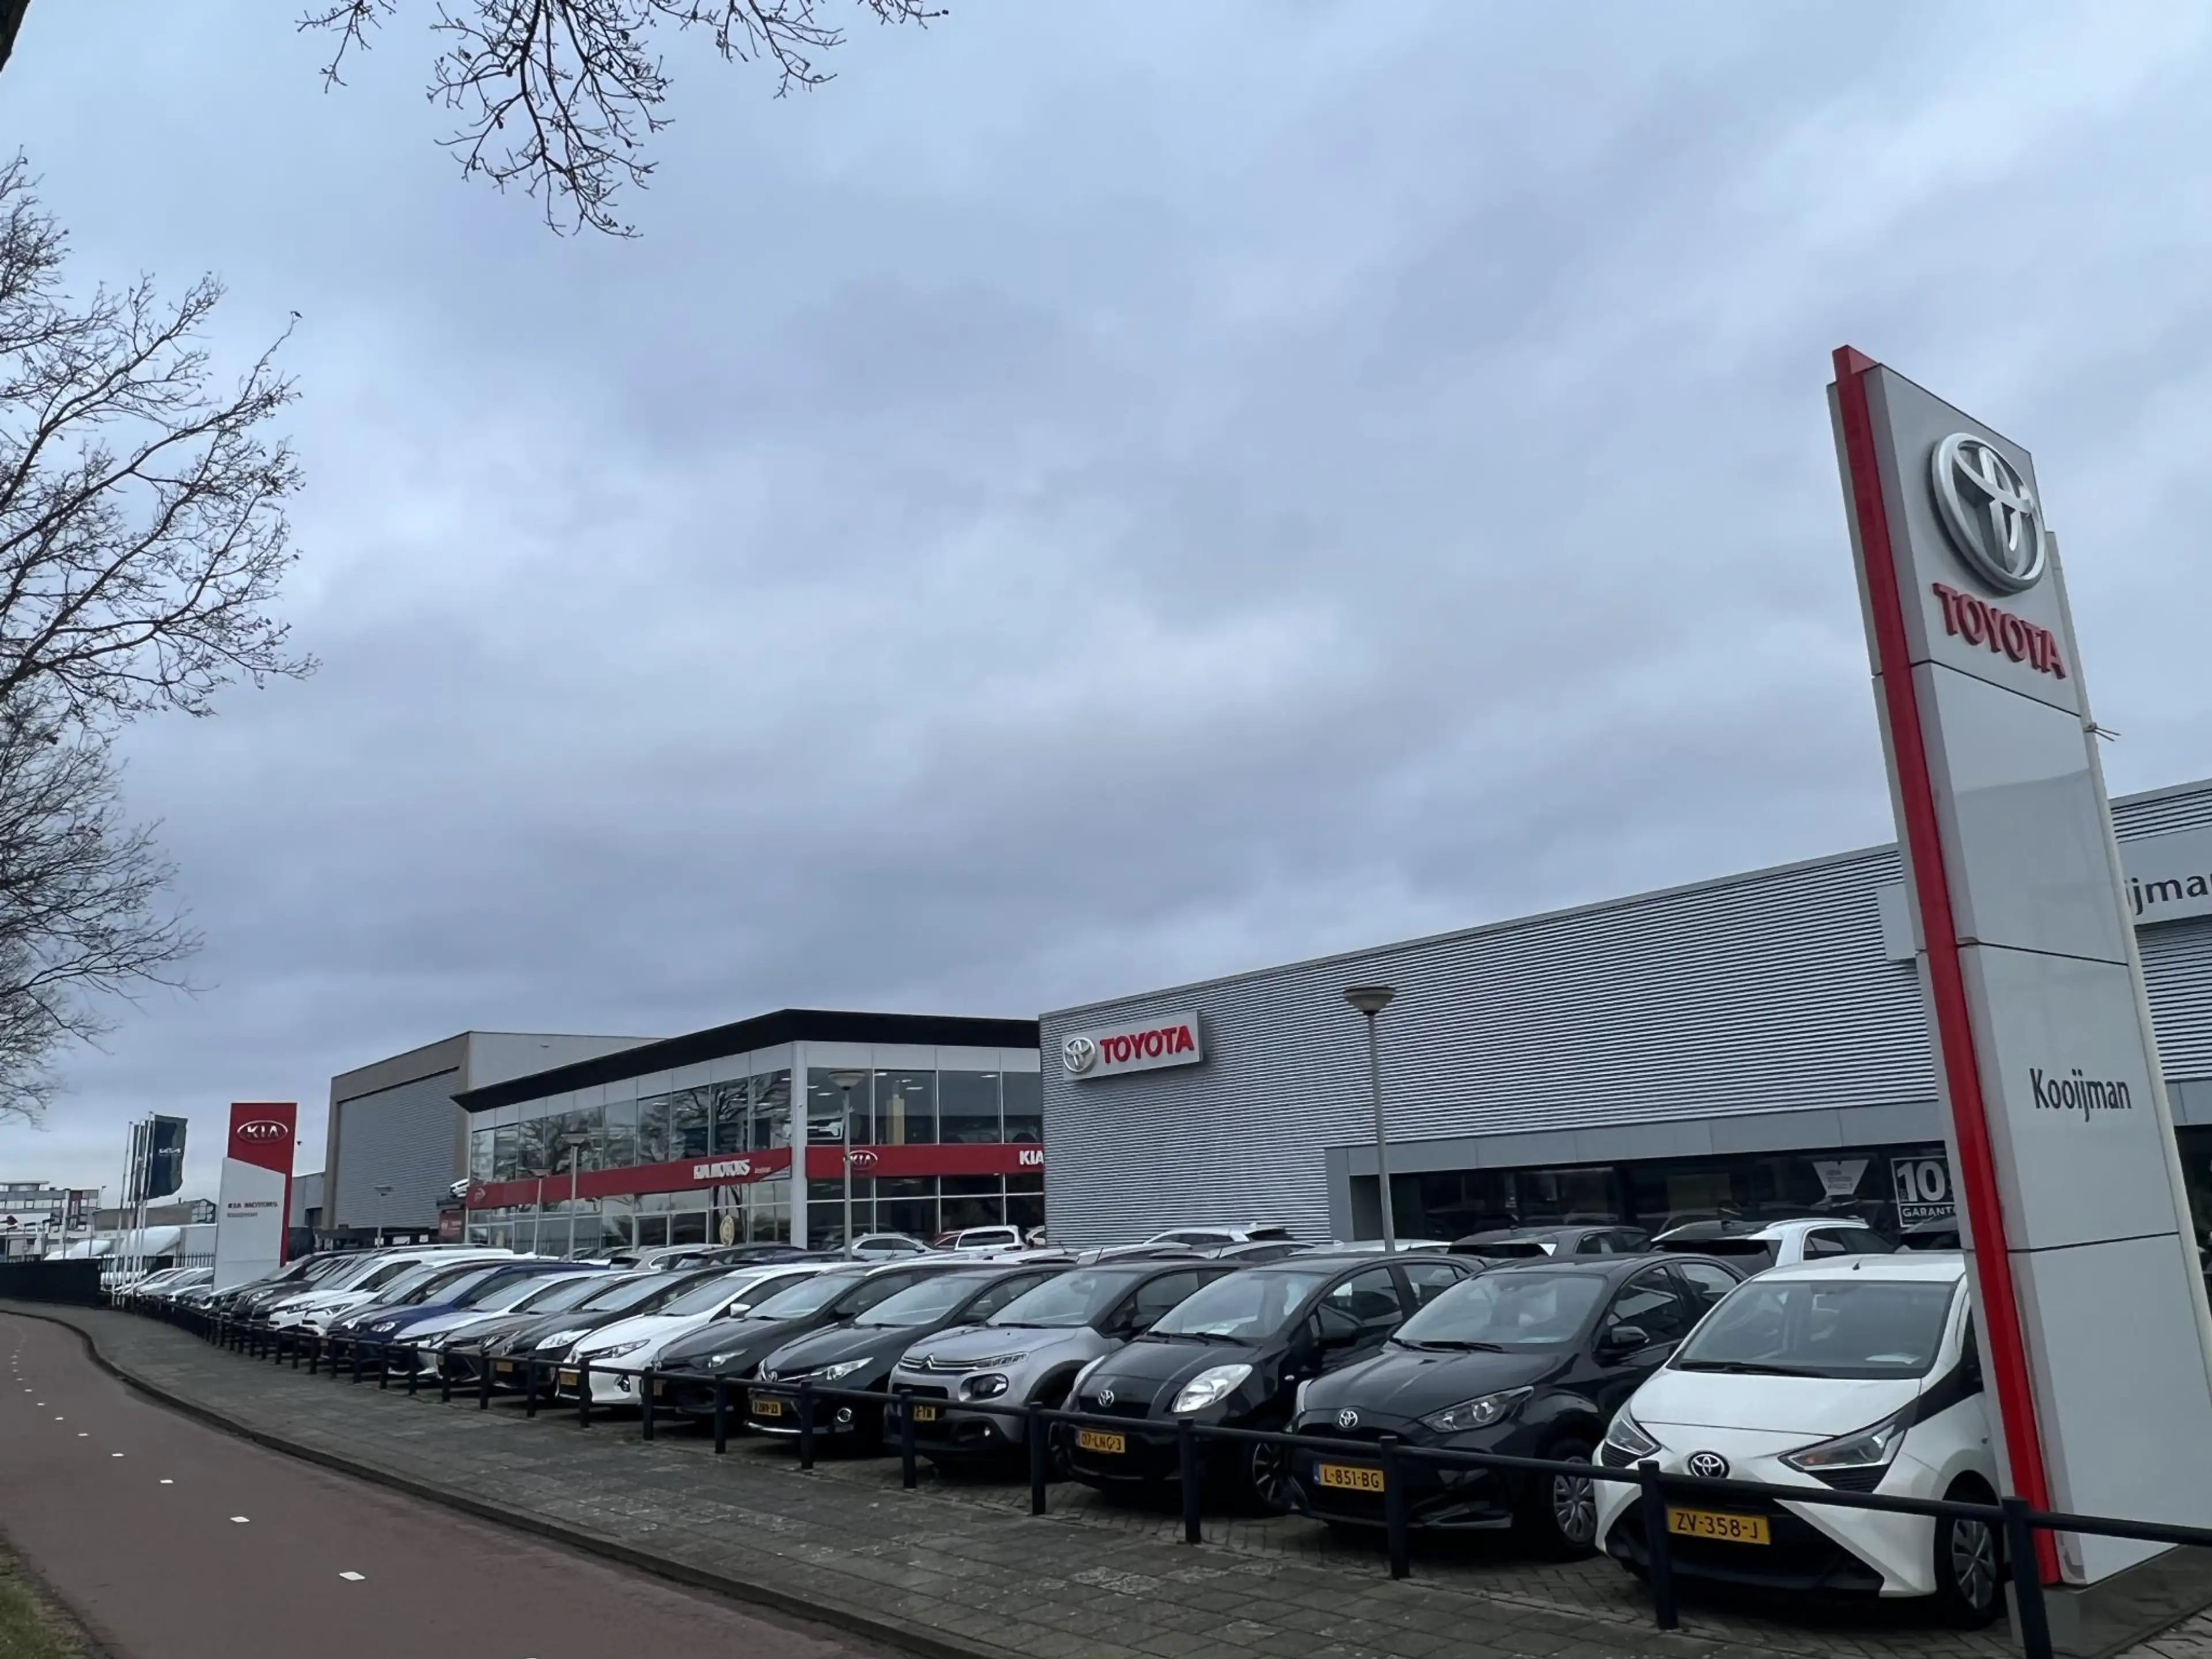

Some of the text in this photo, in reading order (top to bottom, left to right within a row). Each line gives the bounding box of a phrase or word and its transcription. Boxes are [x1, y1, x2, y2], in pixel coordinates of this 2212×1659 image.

[1932, 582, 2066, 679] TOYOTA
[2124, 873, 2212, 915] jma
[1100, 1025, 1194, 1063] TOYOTA
[2029, 1068, 2132, 1123] Kooijman
[1020, 1150, 1044, 1165] KIA
[1897, 1161, 1945, 1202] 10
[1903, 1206, 1955, 1217] GARANT
[1324, 1468, 1380, 1488] L-851-BG
[1676, 1512, 1758, 1539] ZV-358-J
